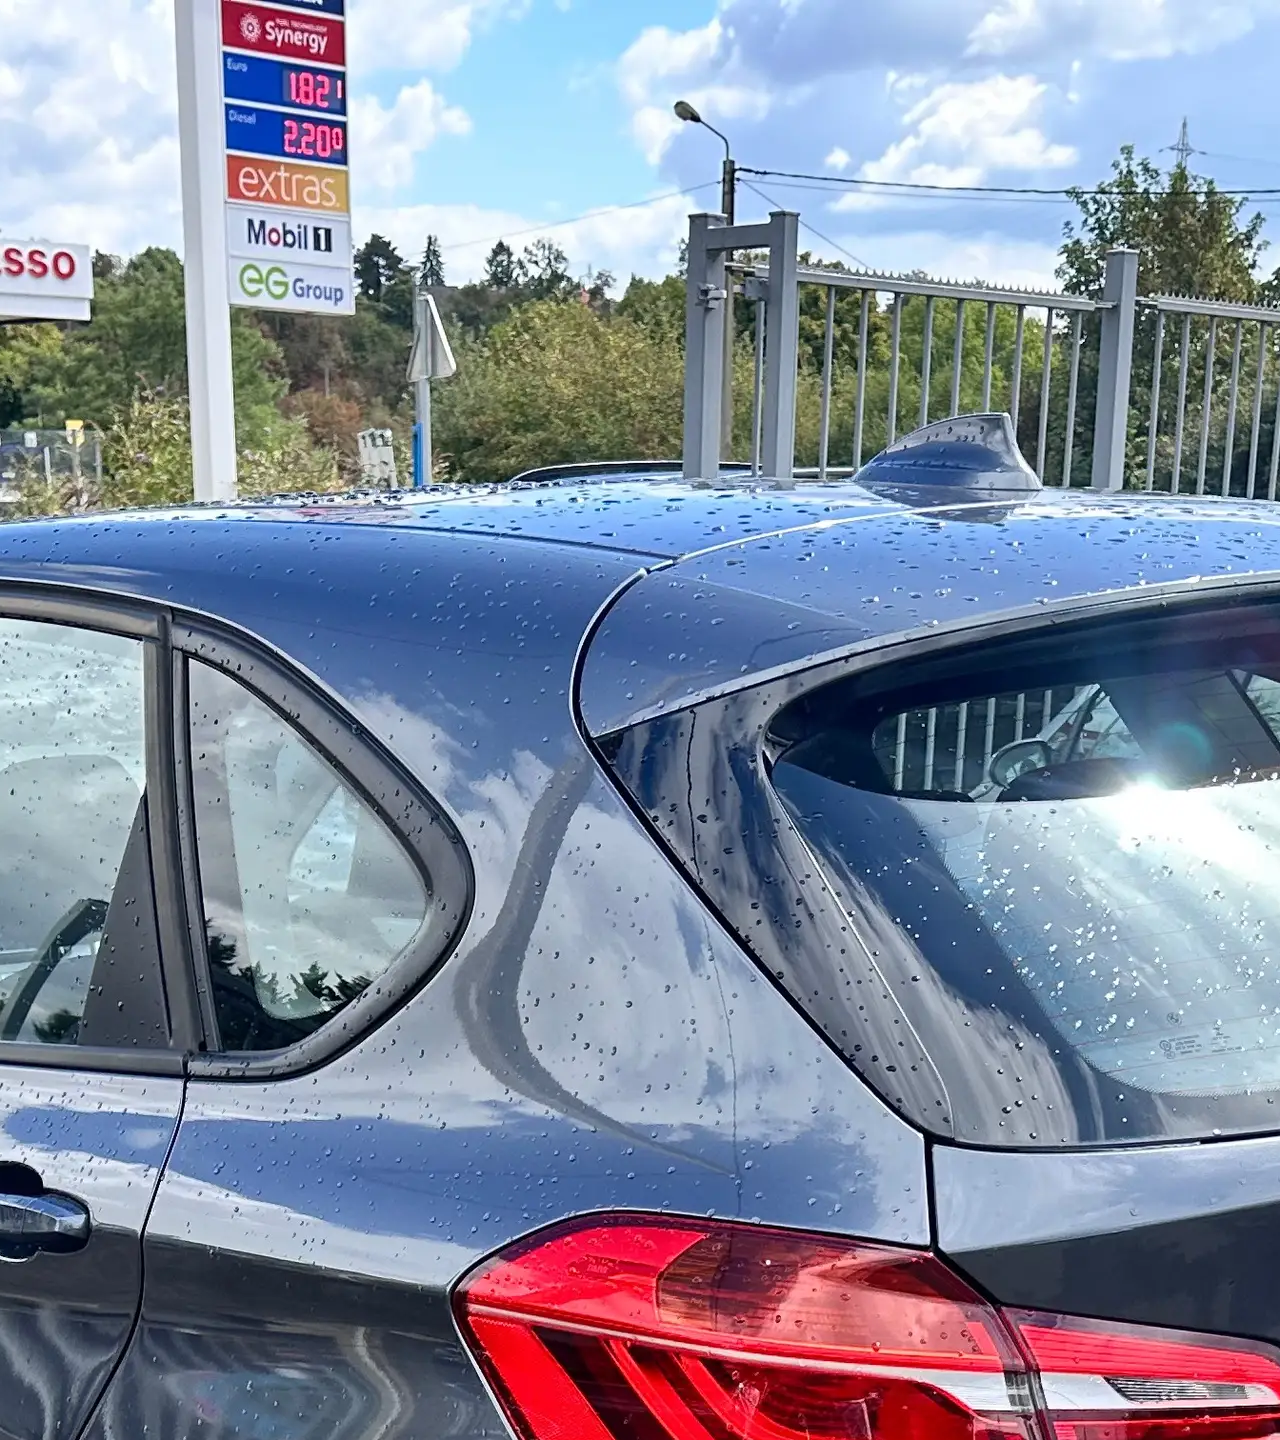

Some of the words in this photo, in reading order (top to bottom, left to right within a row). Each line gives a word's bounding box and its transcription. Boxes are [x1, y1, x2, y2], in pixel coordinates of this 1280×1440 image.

[265, 20, 328, 55] Synergy
[228, 110, 257, 125] Diesel
[247, 218, 308, 250] Mobil
[293, 277, 344, 306] Group
